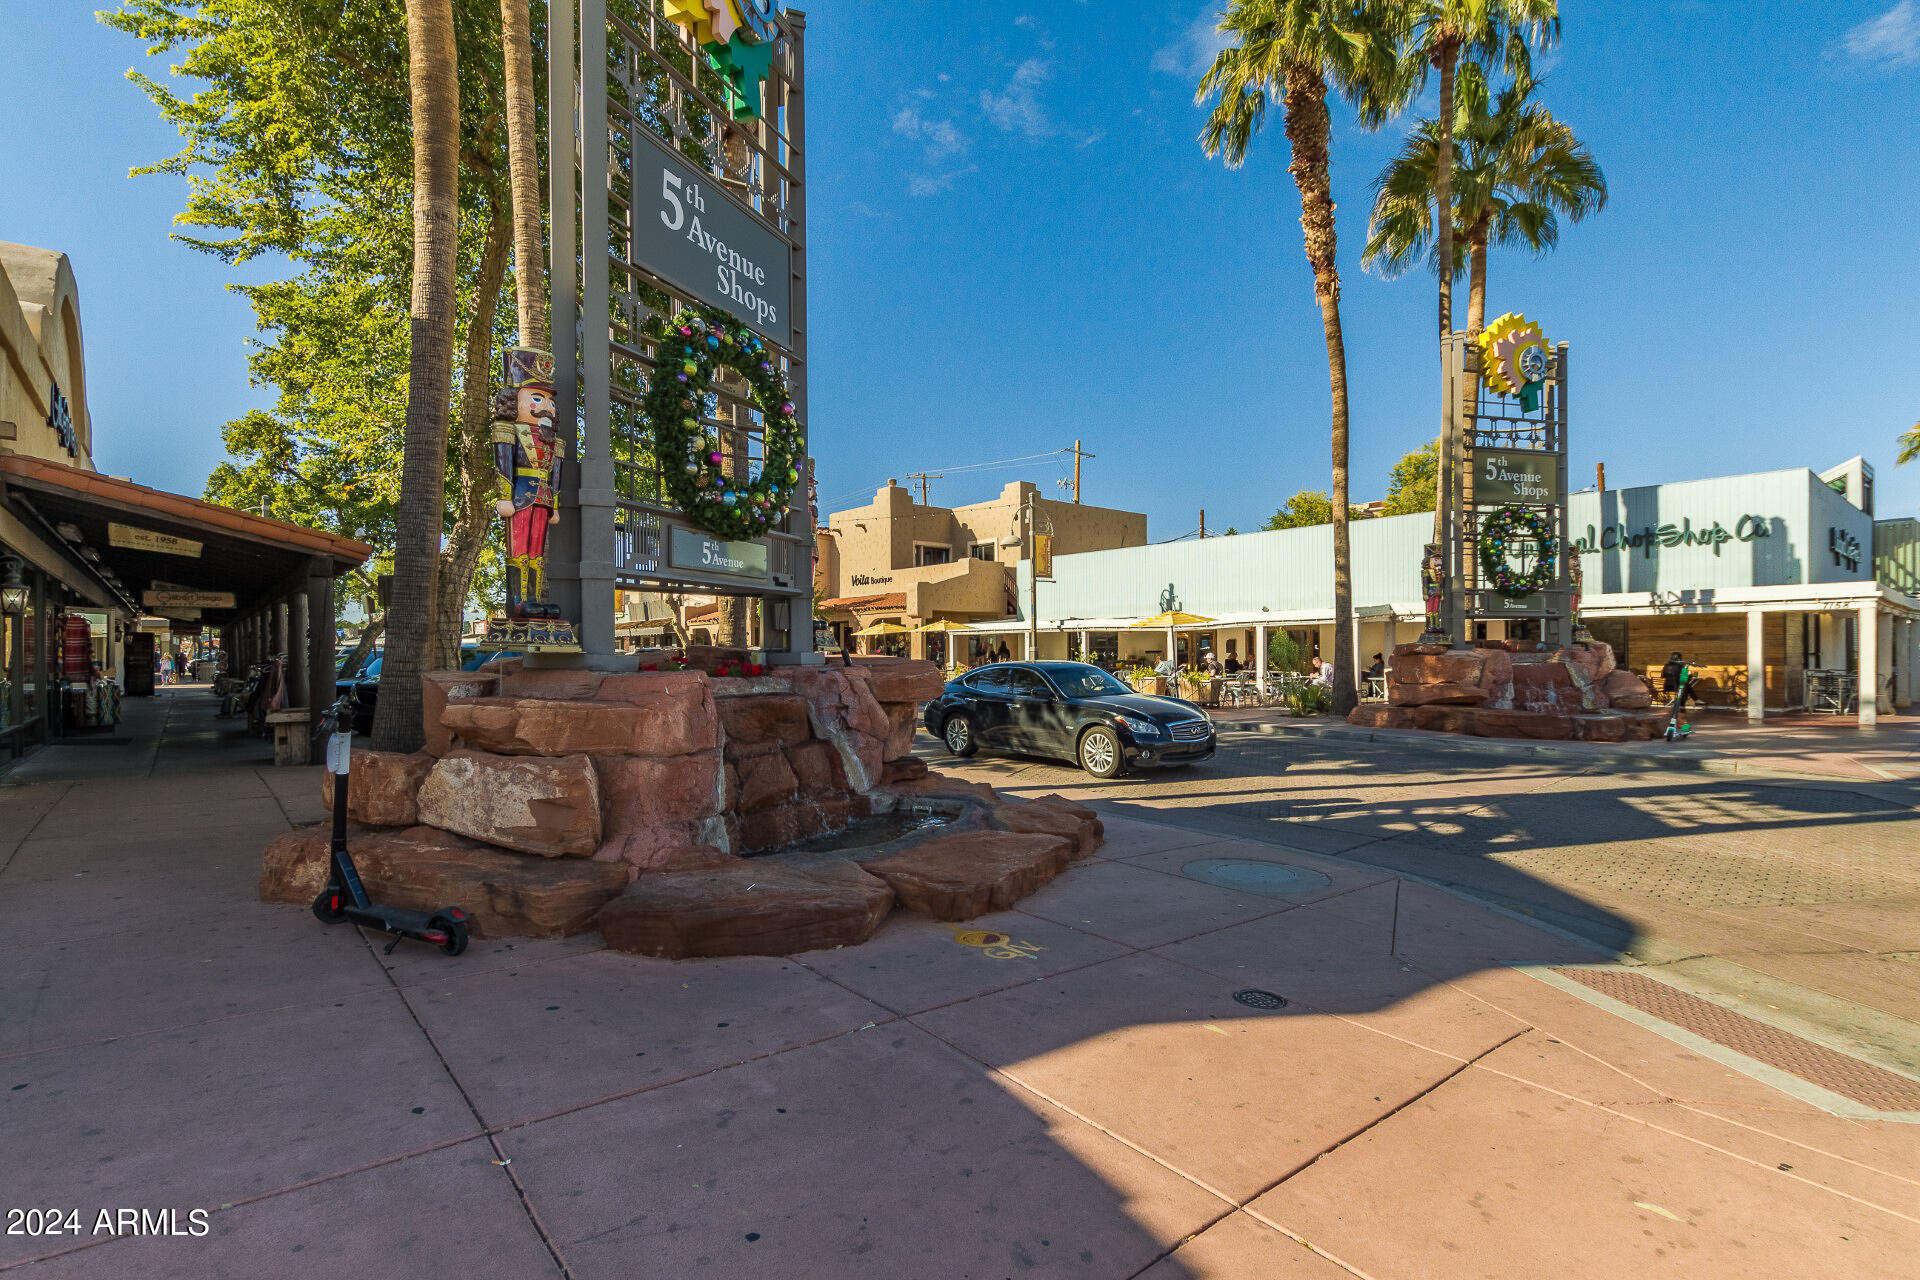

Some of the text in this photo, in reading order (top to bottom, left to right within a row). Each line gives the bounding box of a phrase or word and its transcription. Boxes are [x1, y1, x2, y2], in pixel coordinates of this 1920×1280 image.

[661, 168, 705, 230] 5th
[686, 215, 765, 286] Avenue
[717, 264, 777, 325] Shops
[1485, 456, 1508, 480] 5th
[1498, 469, 1542, 482] Avenue
[1513, 482, 1549, 499] Shops
[155, 535, 178, 545] 1958
[702, 541, 719, 565] 5th
[712, 554, 744, 569] Avenue
